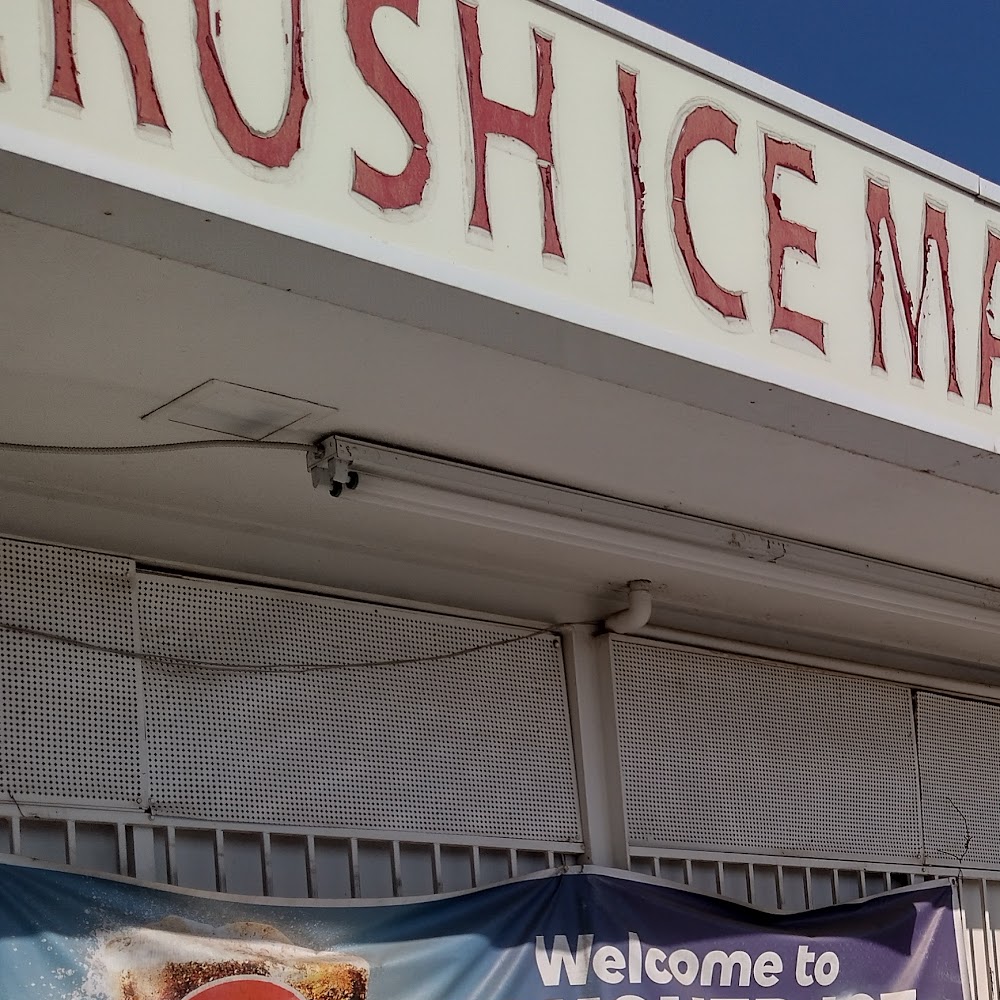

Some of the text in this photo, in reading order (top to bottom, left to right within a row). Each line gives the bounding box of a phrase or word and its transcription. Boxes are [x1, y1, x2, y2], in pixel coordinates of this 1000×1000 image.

[616, 61, 826, 355] ICE
[535, 931, 840, 988] Welcome to
